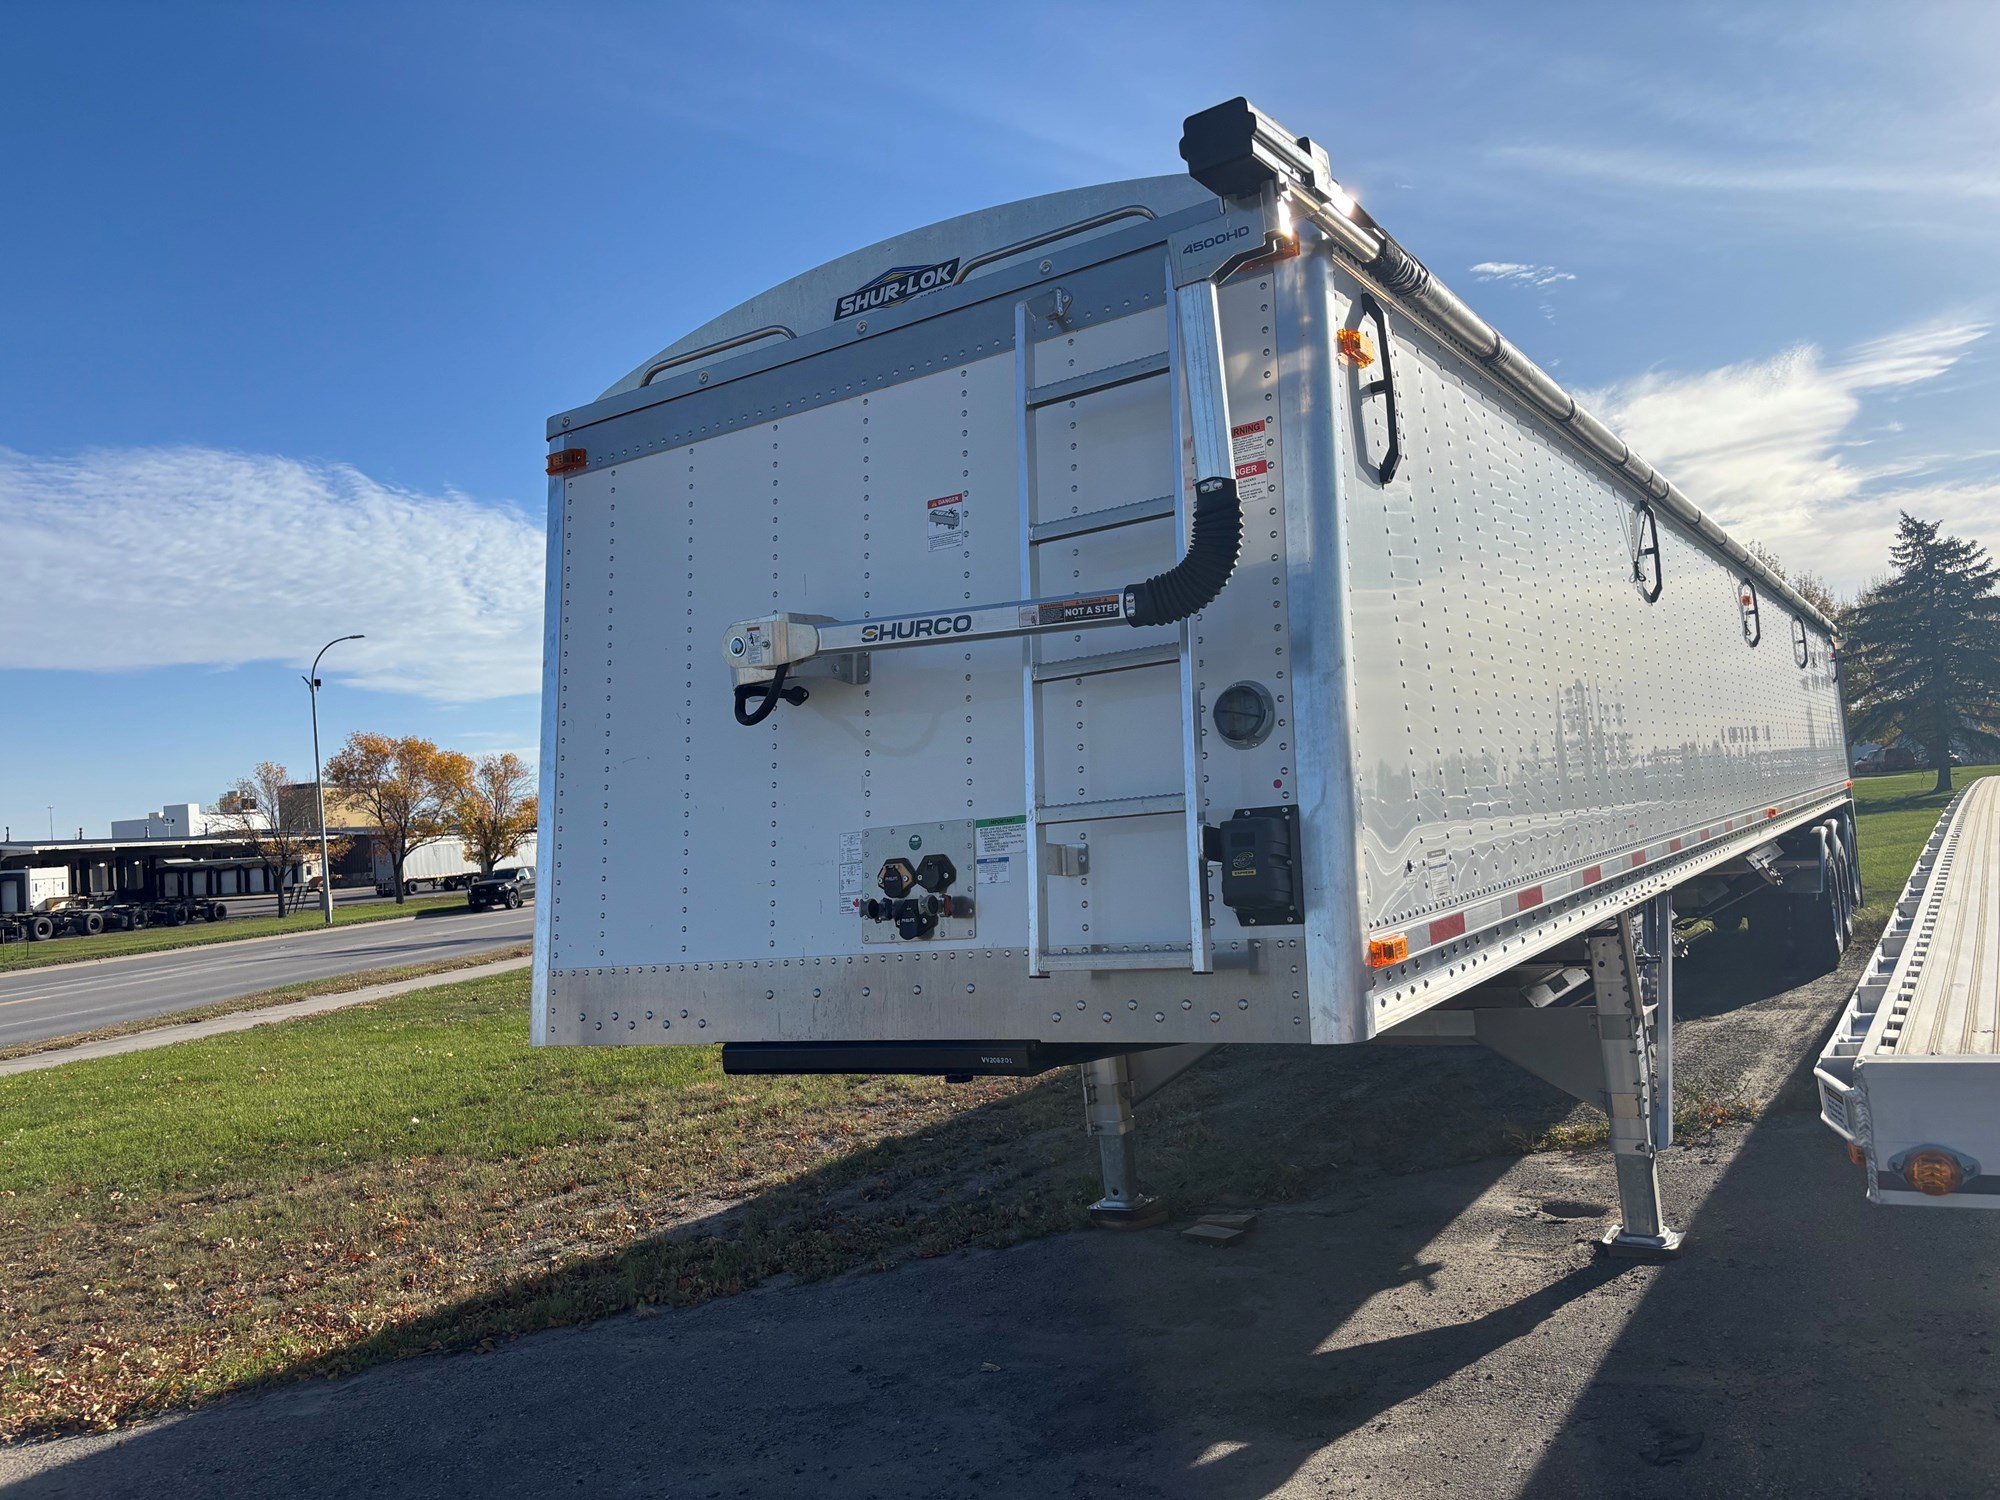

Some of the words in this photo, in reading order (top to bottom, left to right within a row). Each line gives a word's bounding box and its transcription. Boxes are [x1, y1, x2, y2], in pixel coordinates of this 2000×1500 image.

[1182, 225, 1250, 255] 4500HD
[839, 263, 954, 317] SHUR-LOK
[1232, 422, 1260, 437] RNING
[1235, 464, 1258, 477] NGER
[937, 495, 959, 506] DANGER
[1065, 607, 1085, 617] NOT
[1086, 606, 1093, 615] A
[1094, 603, 1119, 614] STEP
[861, 614, 972, 643] SHURCO
